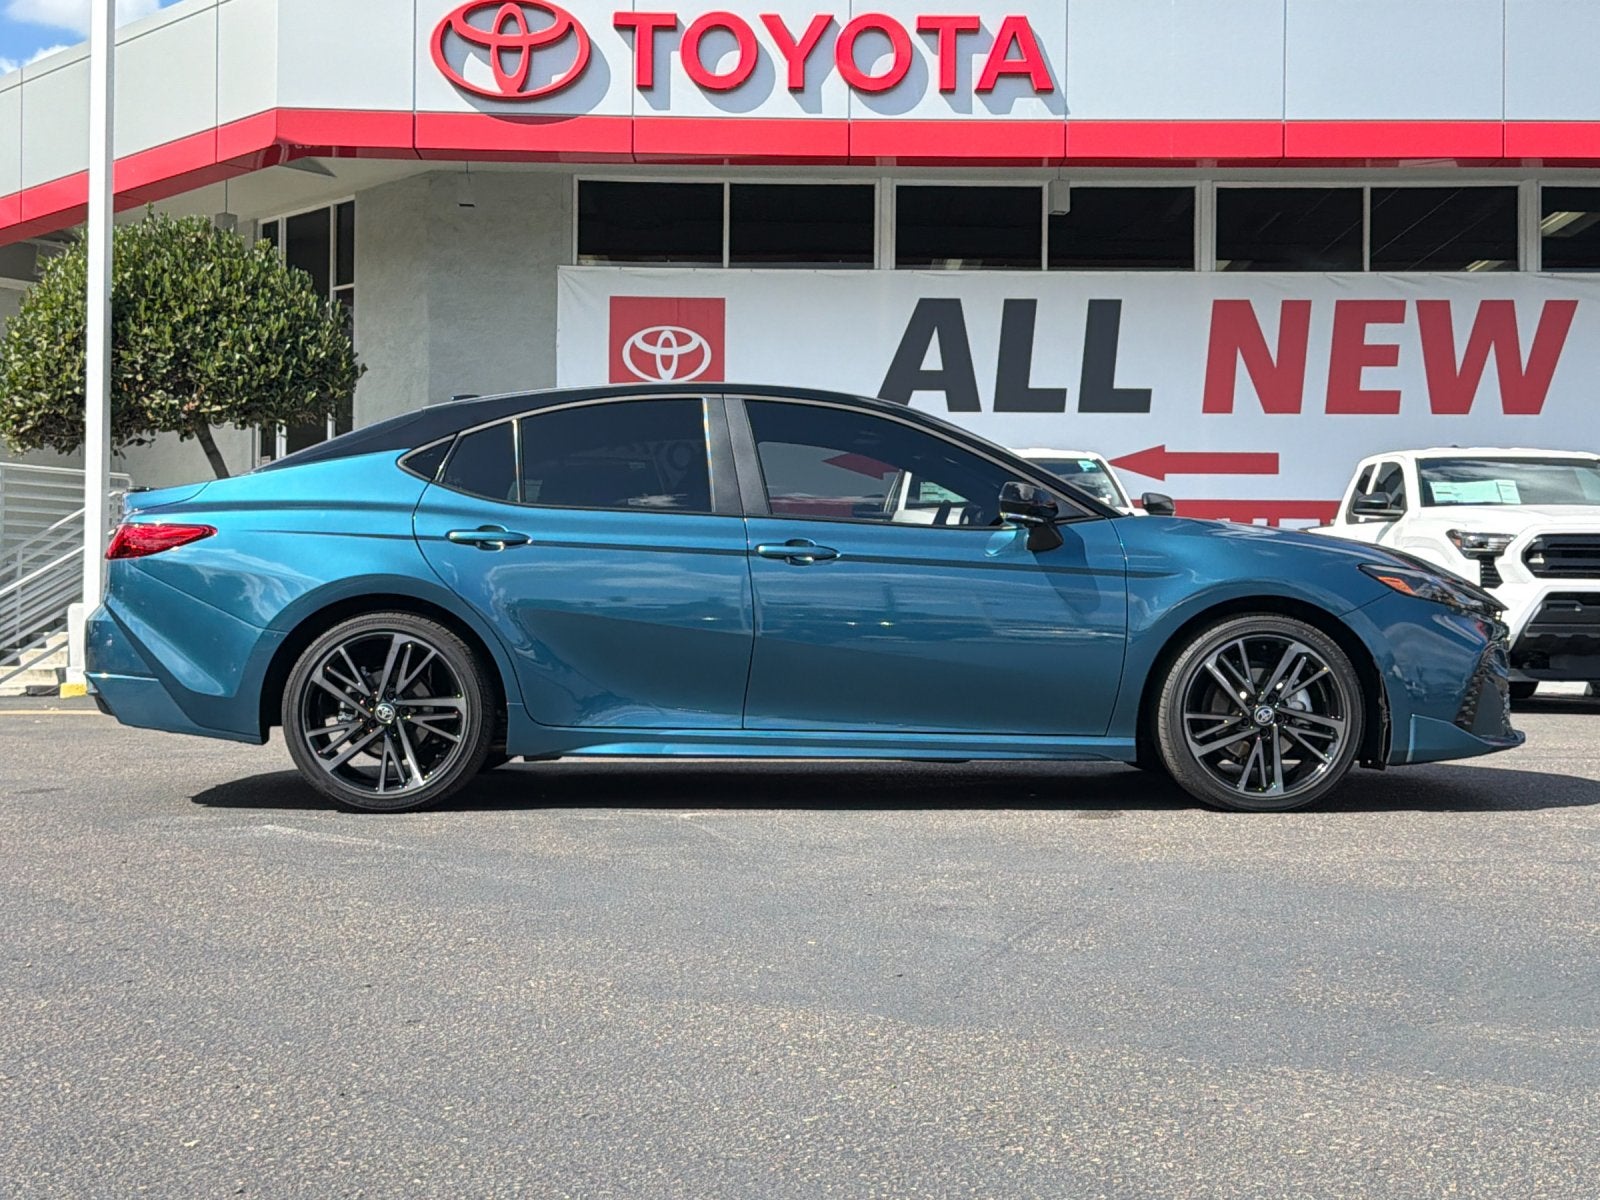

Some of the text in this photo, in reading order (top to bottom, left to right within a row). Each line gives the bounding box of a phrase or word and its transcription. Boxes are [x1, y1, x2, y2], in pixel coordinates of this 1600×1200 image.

[613, 11, 1054, 94] TOYOTA
[877, 298, 1578, 414] ALL NEW
